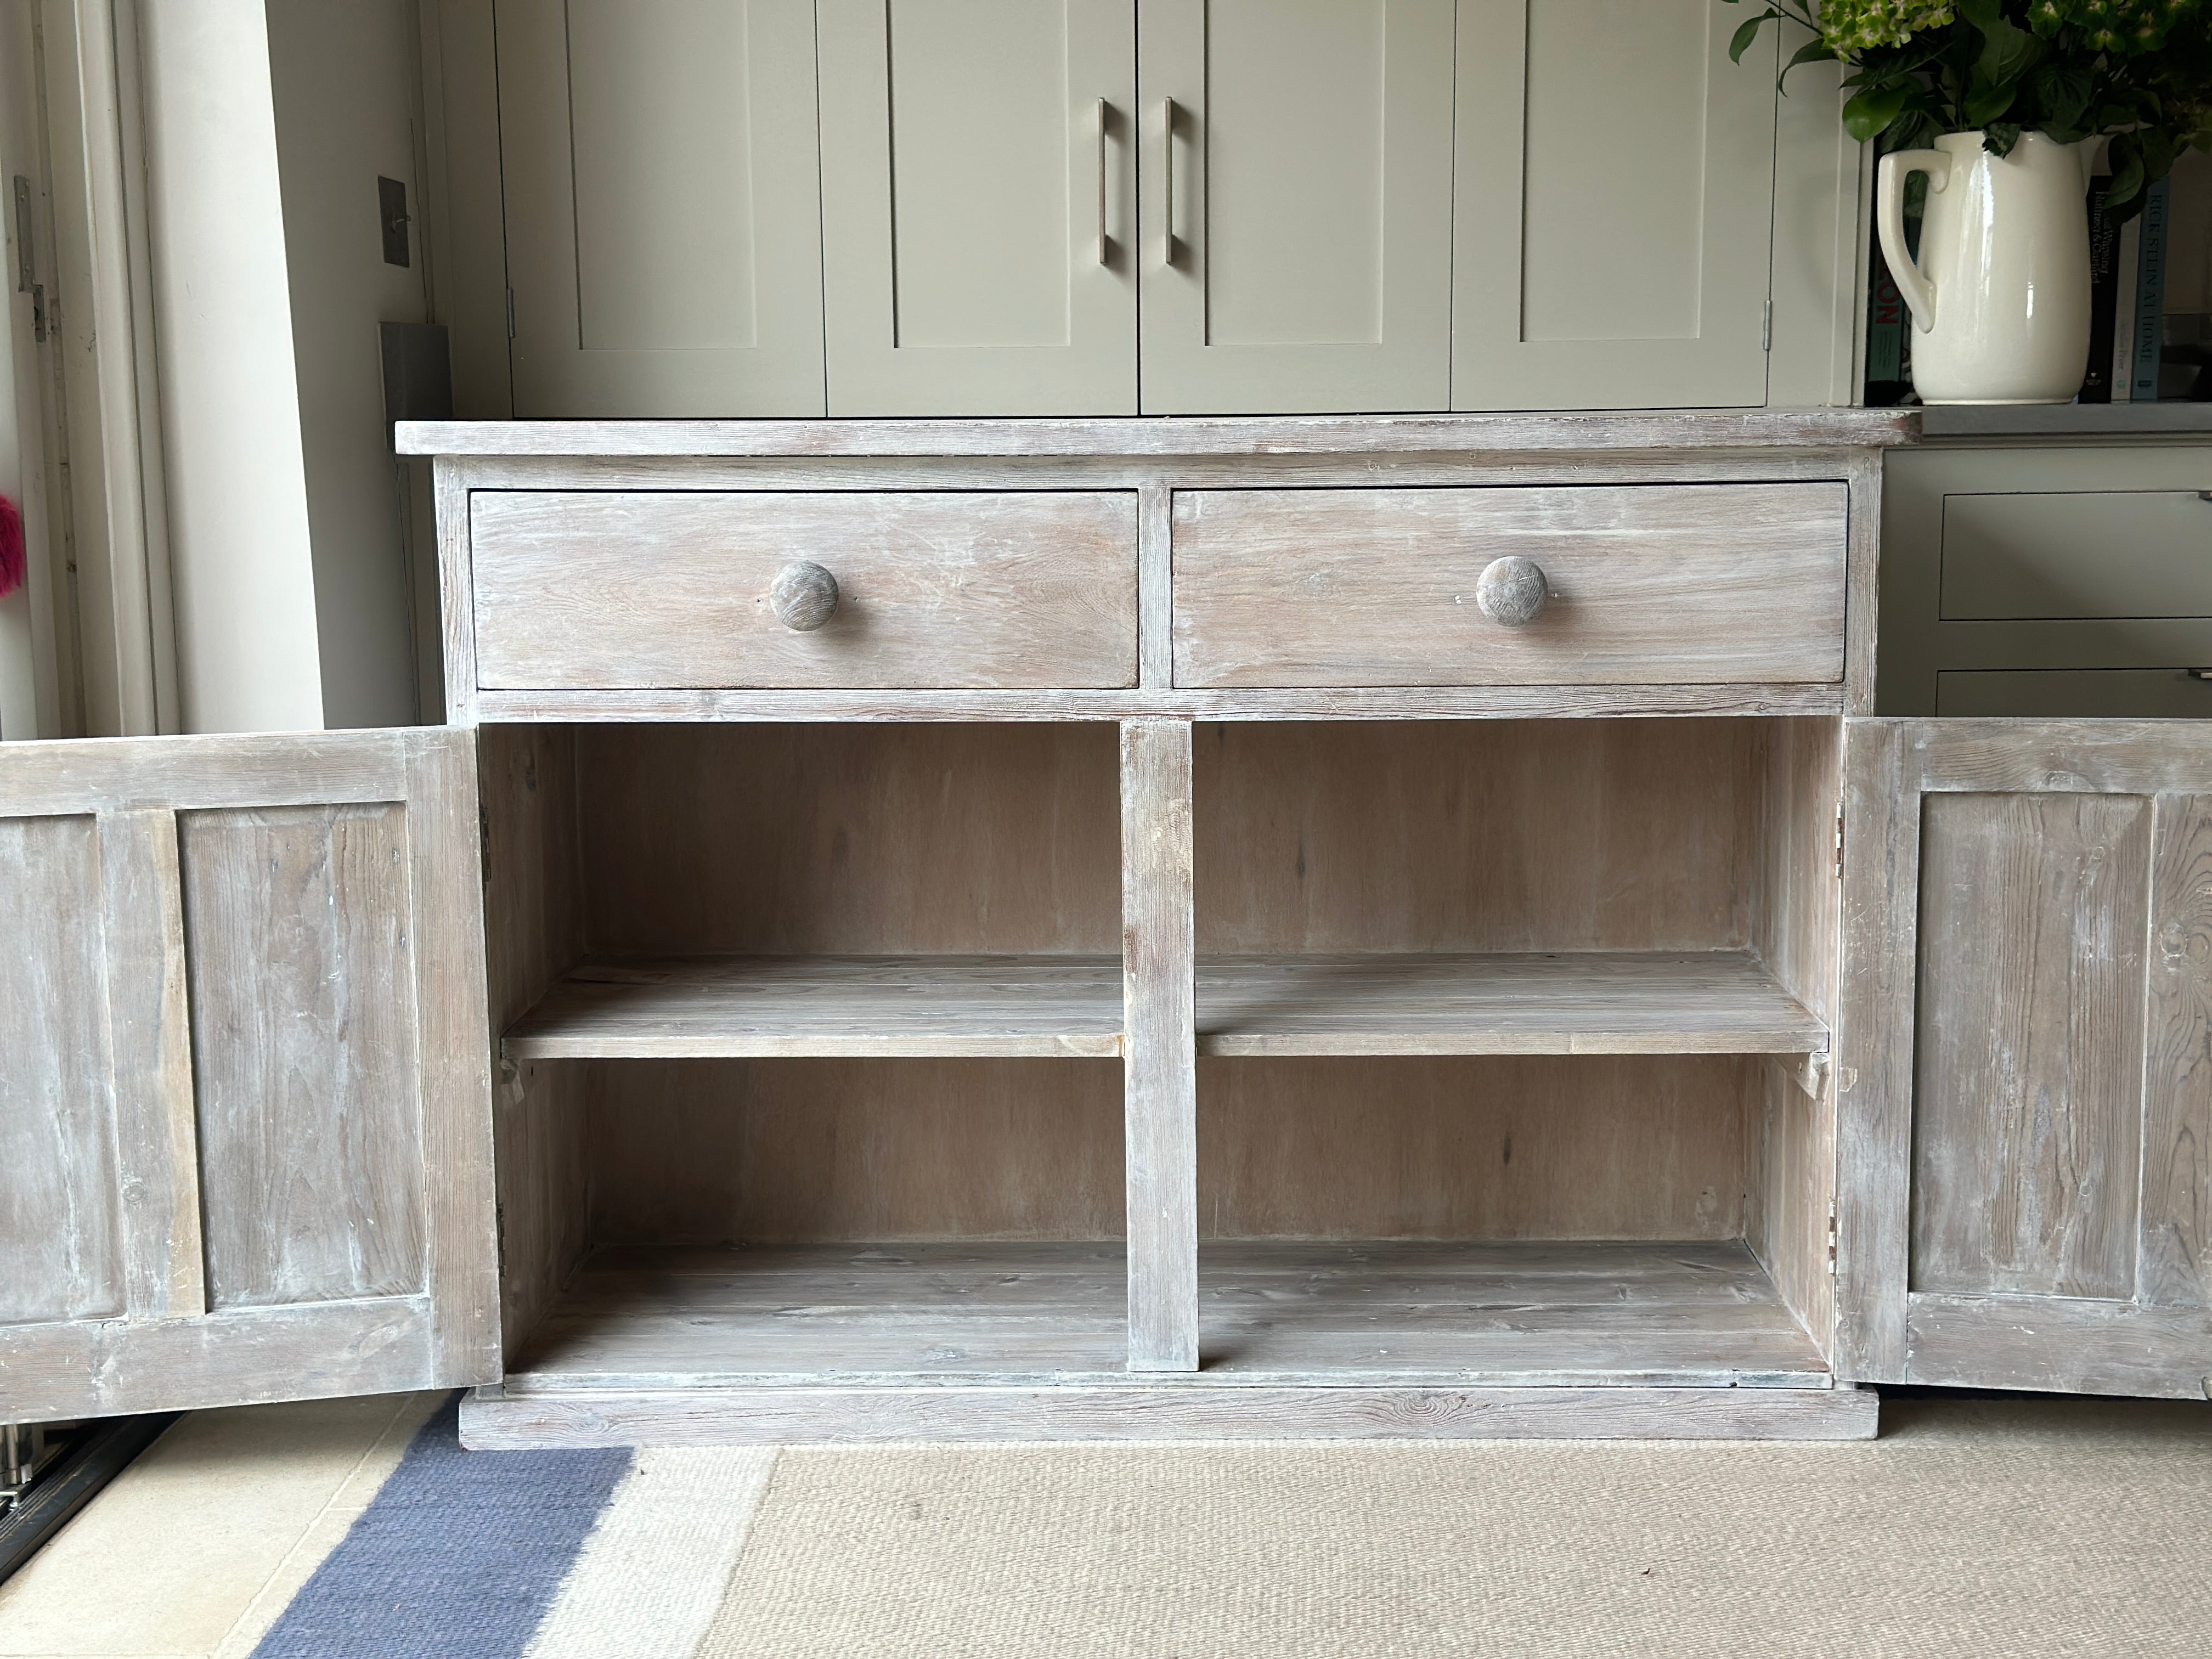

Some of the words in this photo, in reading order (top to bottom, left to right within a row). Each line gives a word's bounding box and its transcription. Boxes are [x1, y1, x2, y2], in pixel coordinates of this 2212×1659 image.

[2149, 195, 2163, 232] RICK
[2145, 238, 2159, 285] STEIN
[2143, 291, 2155, 309] AT
[2140, 316, 2154, 363] HOME
